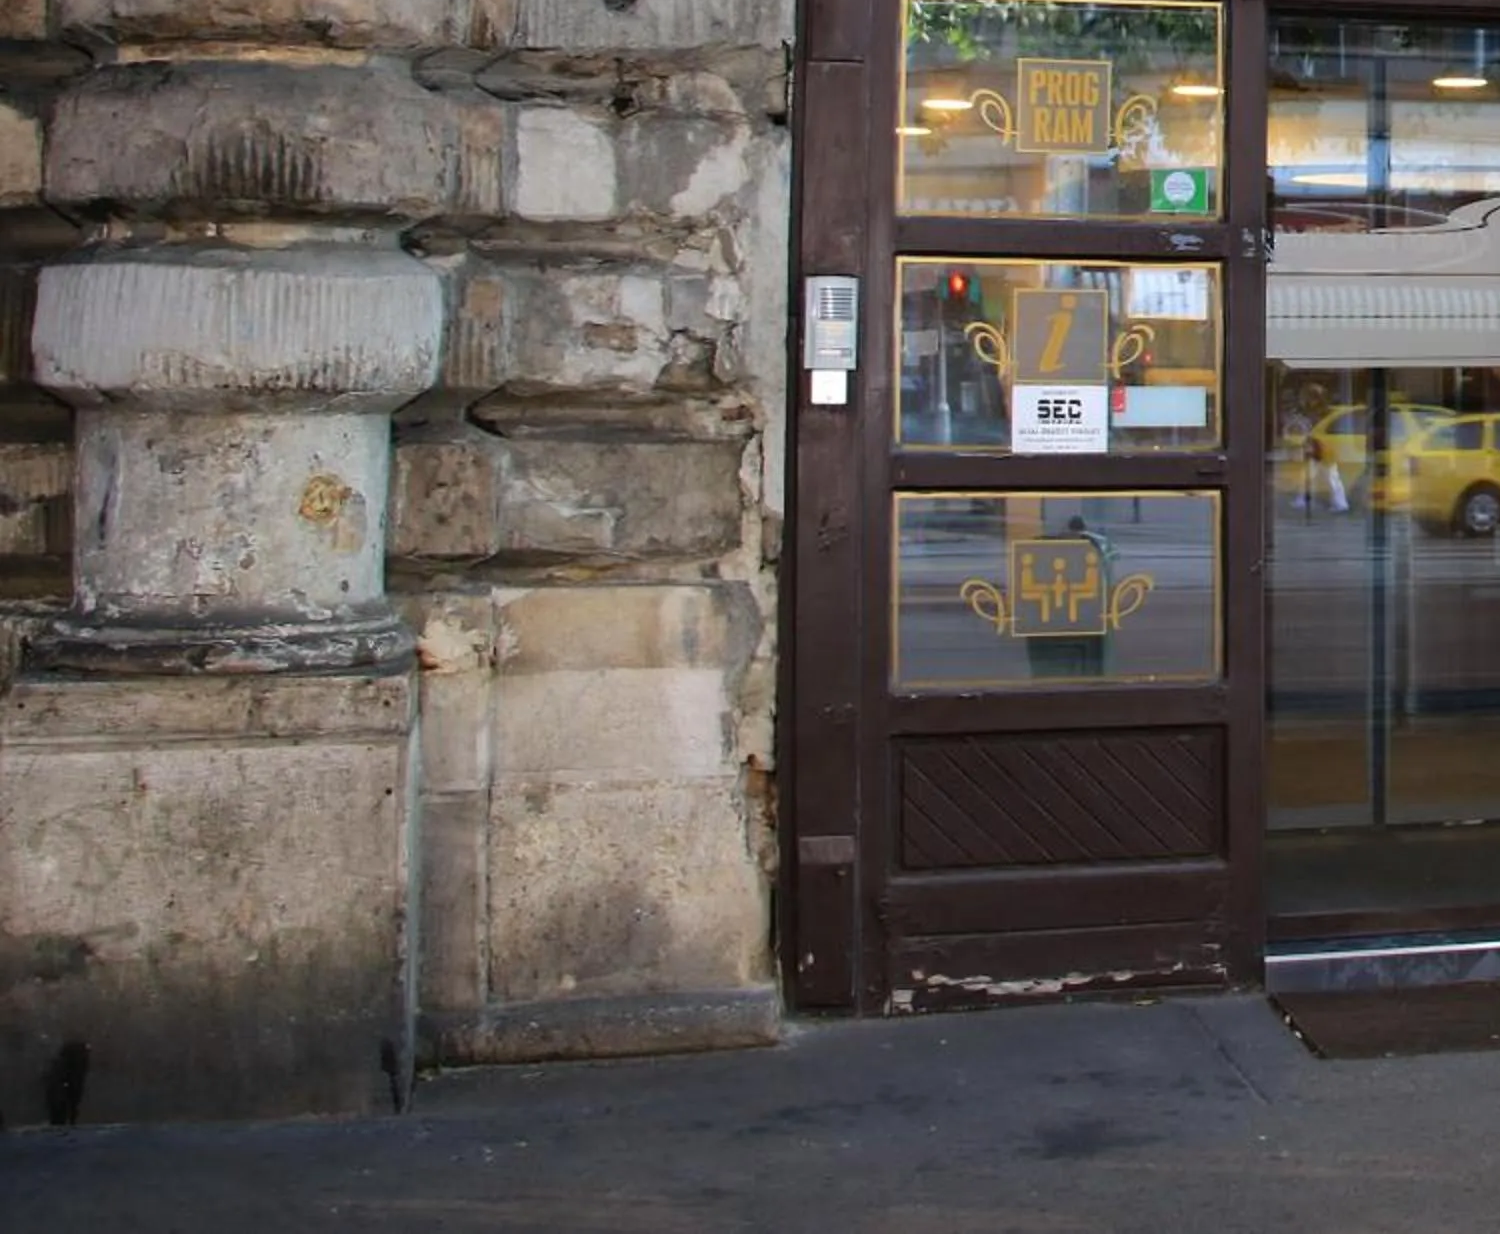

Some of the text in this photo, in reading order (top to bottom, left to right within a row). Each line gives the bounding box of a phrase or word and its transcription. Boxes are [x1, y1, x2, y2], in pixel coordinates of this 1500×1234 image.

[1030, 69, 1099, 106] PROG
[1034, 108, 1093, 143] RAM
[1037, 399, 1082, 419] SEC
